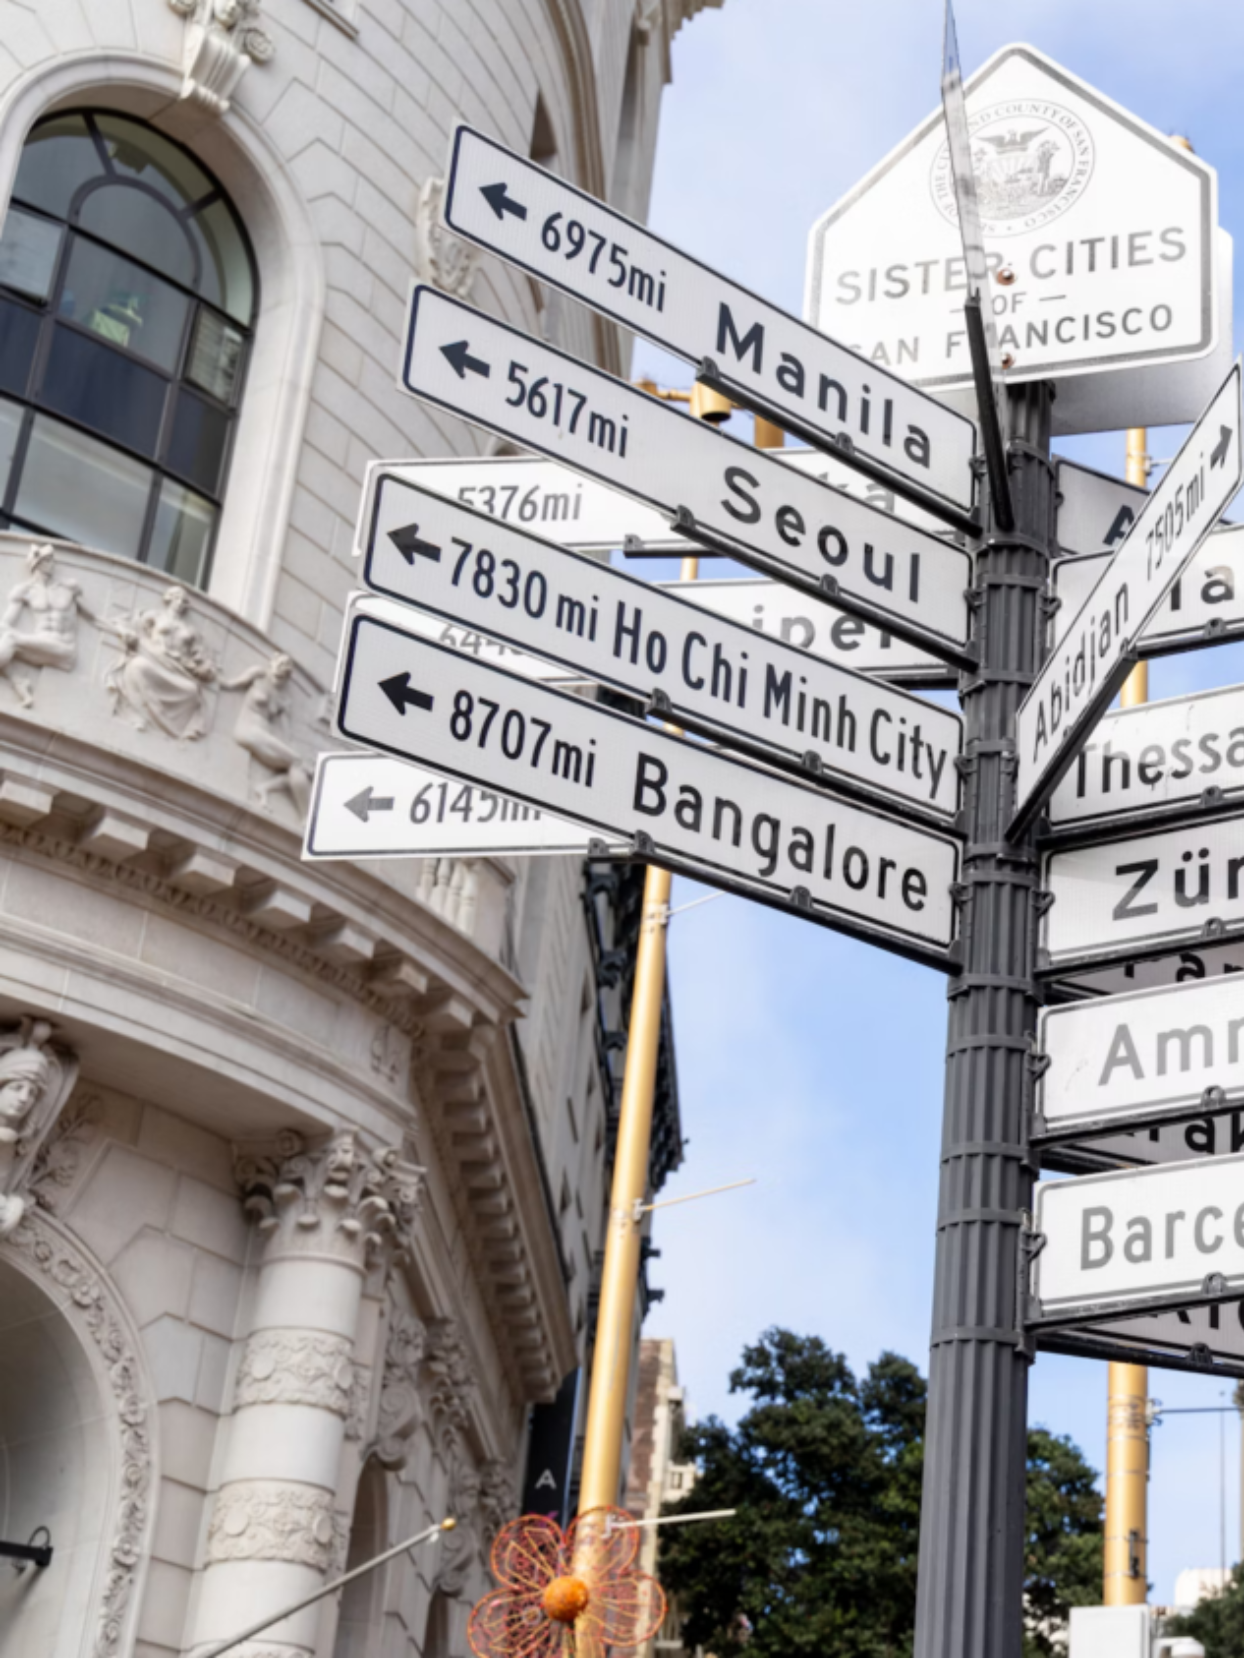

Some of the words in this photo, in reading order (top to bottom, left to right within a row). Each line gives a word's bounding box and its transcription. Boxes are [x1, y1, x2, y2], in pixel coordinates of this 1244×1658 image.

[541, 212, 666, 312] 6975mi
[715, 301, 932, 469] Manila
[847, 336, 920, 368] AN
[946, 303, 1174, 359] FANCISCO
[992, 291, 1027, 316] OF
[1029, 226, 1188, 280] CITIES
[504, 360, 629, 458] 5617mi
[721, 466, 921, 603] Seoul
[612, 601, 667, 673] Ho
[682, 631, 748, 708] Chi
[764, 663, 857, 753] Minh
[870, 711, 948, 800] City
[1033, 582, 1129, 764] Abidjan
[449, 690, 597, 788] 8707mi
[633, 752, 928, 911] Bangalore
